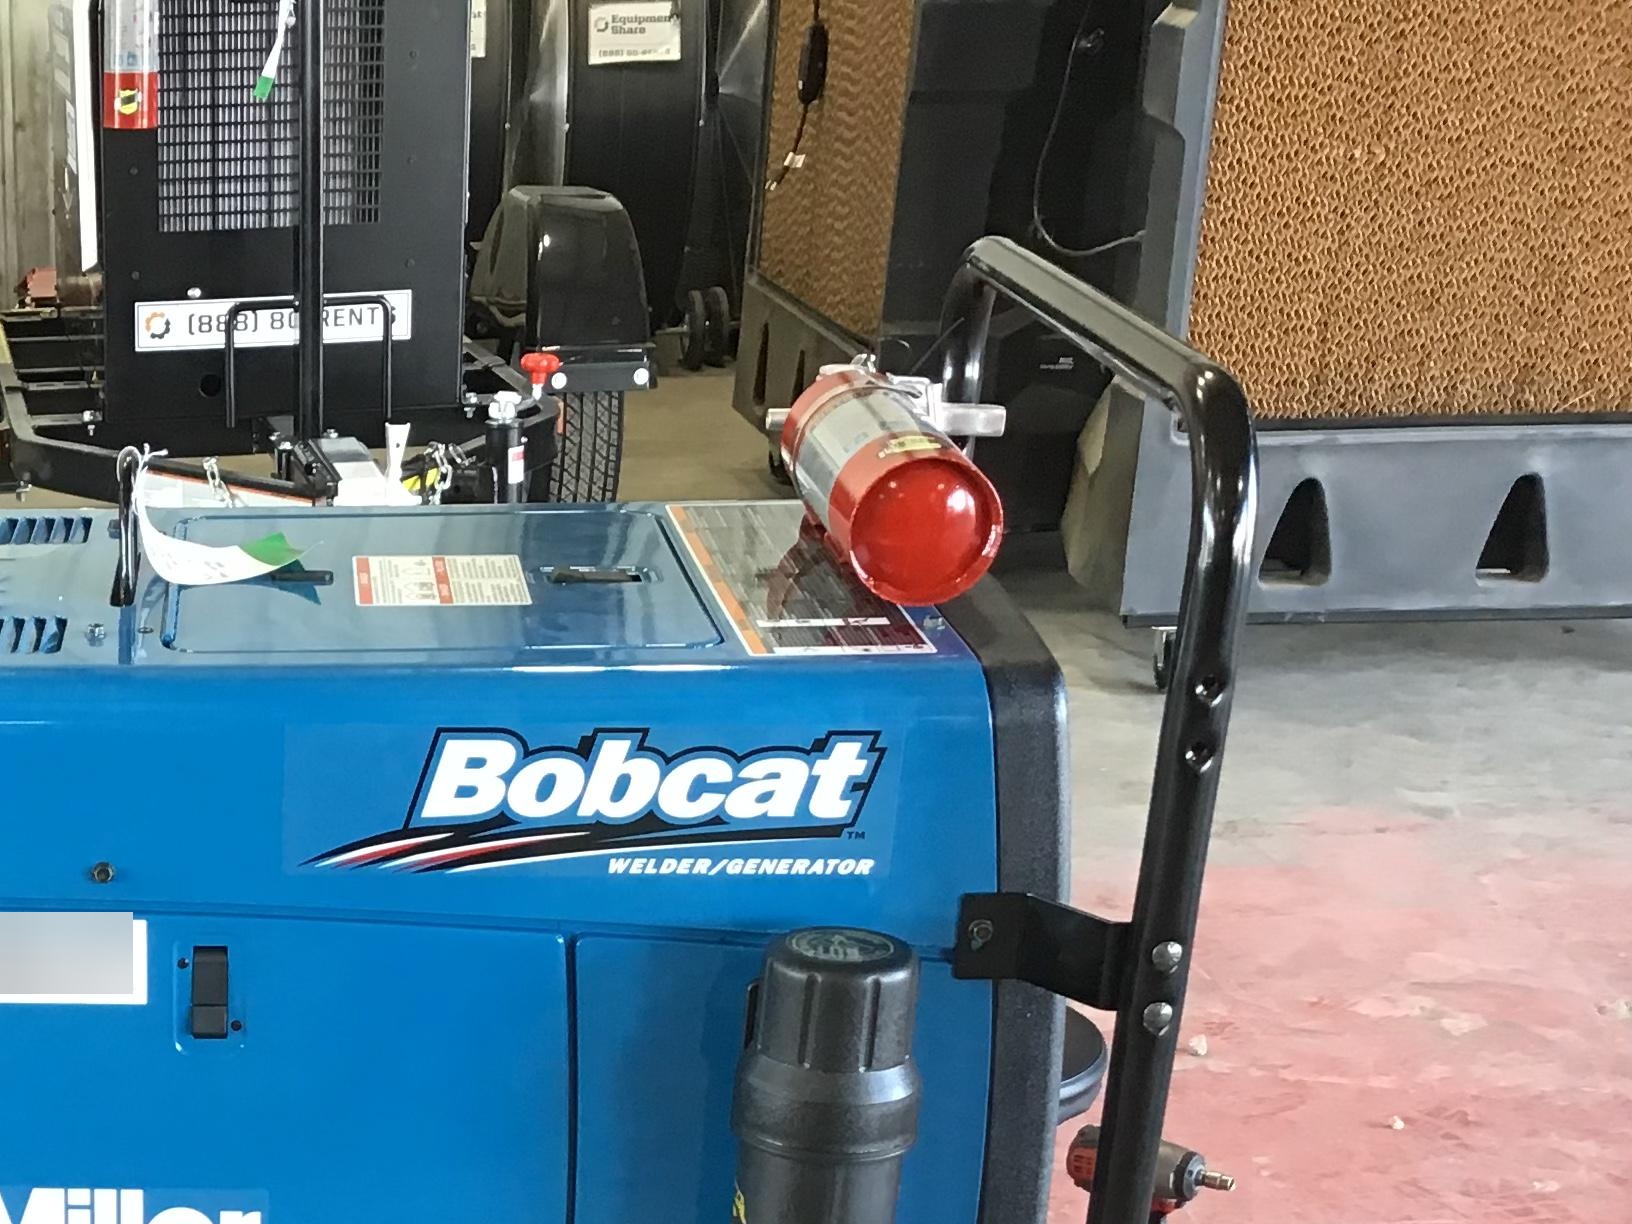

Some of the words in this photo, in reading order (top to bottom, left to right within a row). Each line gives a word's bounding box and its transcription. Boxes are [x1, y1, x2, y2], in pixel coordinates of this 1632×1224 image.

[611, 14, 673, 24] Equipmen
[611, 25, 646, 35] Share
[270, 305, 396, 330] 80RENT
[414, 734, 878, 824] Bobcat
[606, 857, 875, 877] WELDER/GENERATOR
